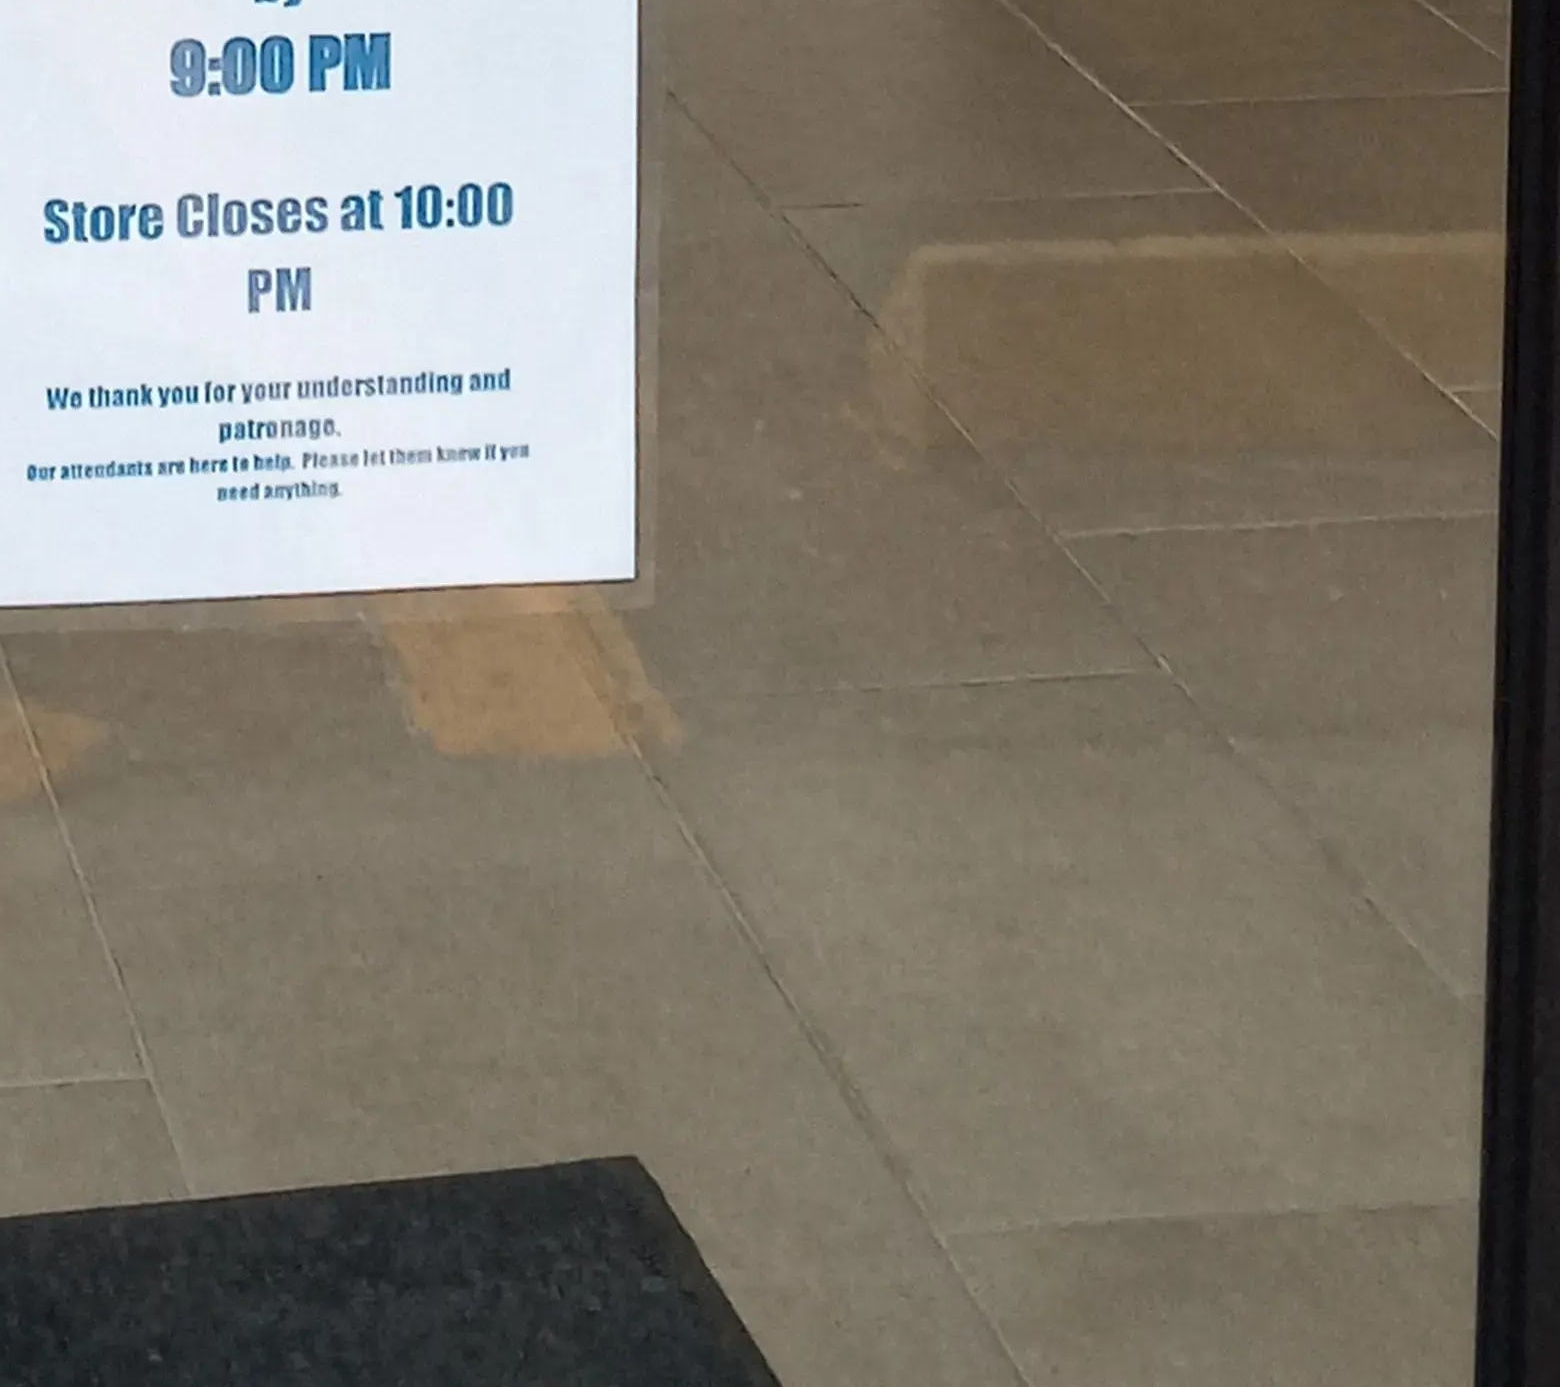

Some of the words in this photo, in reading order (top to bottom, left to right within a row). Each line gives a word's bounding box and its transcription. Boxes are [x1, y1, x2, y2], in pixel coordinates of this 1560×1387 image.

[171, 34, 294, 97] 9:00
[309, 32, 391, 93] PM
[44, 199, 163, 244] Store
[177, 193, 328, 238] Closes
[341, 189, 384, 232] at
[394, 181, 513, 230] 10:00
[248, 266, 311, 314] PM
[47, 387, 82, 410] We
[89, 384, 152, 408] thank
[158, 385, 198, 408] you
[205, 381, 236, 404] for
[242, 382, 290, 404] your
[298, 371, 462, 398] understanding
[470, 368, 510, 392] and
[219, 418, 341, 444] patronage.
